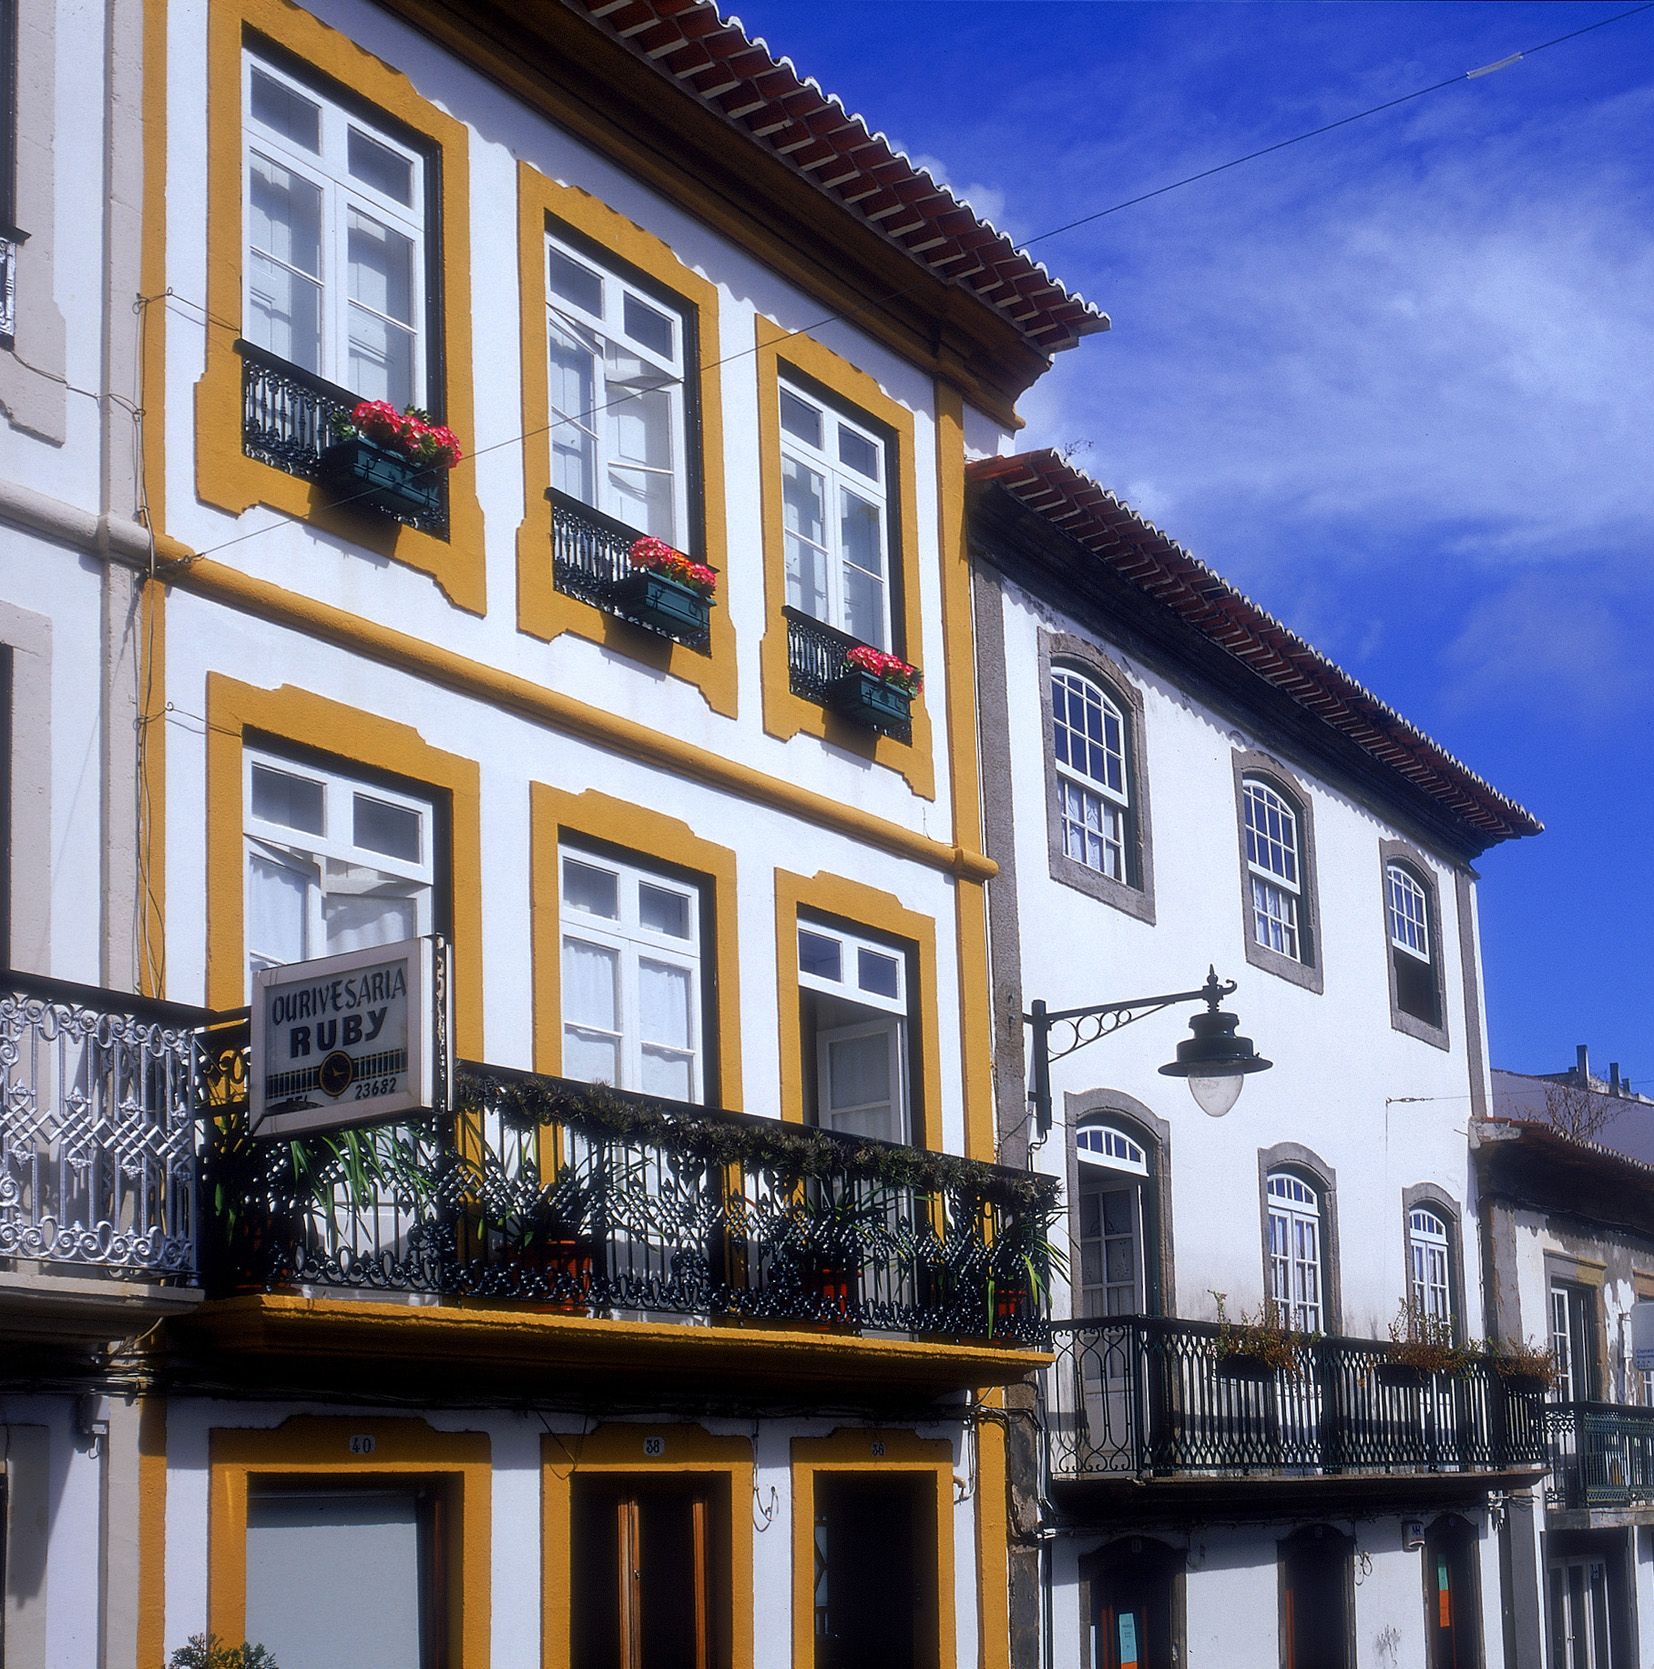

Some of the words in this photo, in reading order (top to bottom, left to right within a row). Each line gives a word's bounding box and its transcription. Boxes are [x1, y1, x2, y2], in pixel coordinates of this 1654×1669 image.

[272, 967, 407, 1025] OURIVESARIA
[291, 1006, 387, 1059] RUBY
[355, 1077, 396, 1099] 23682
[352, 1437, 371, 1453] 40
[646, 1439, 660, 1454] 38
